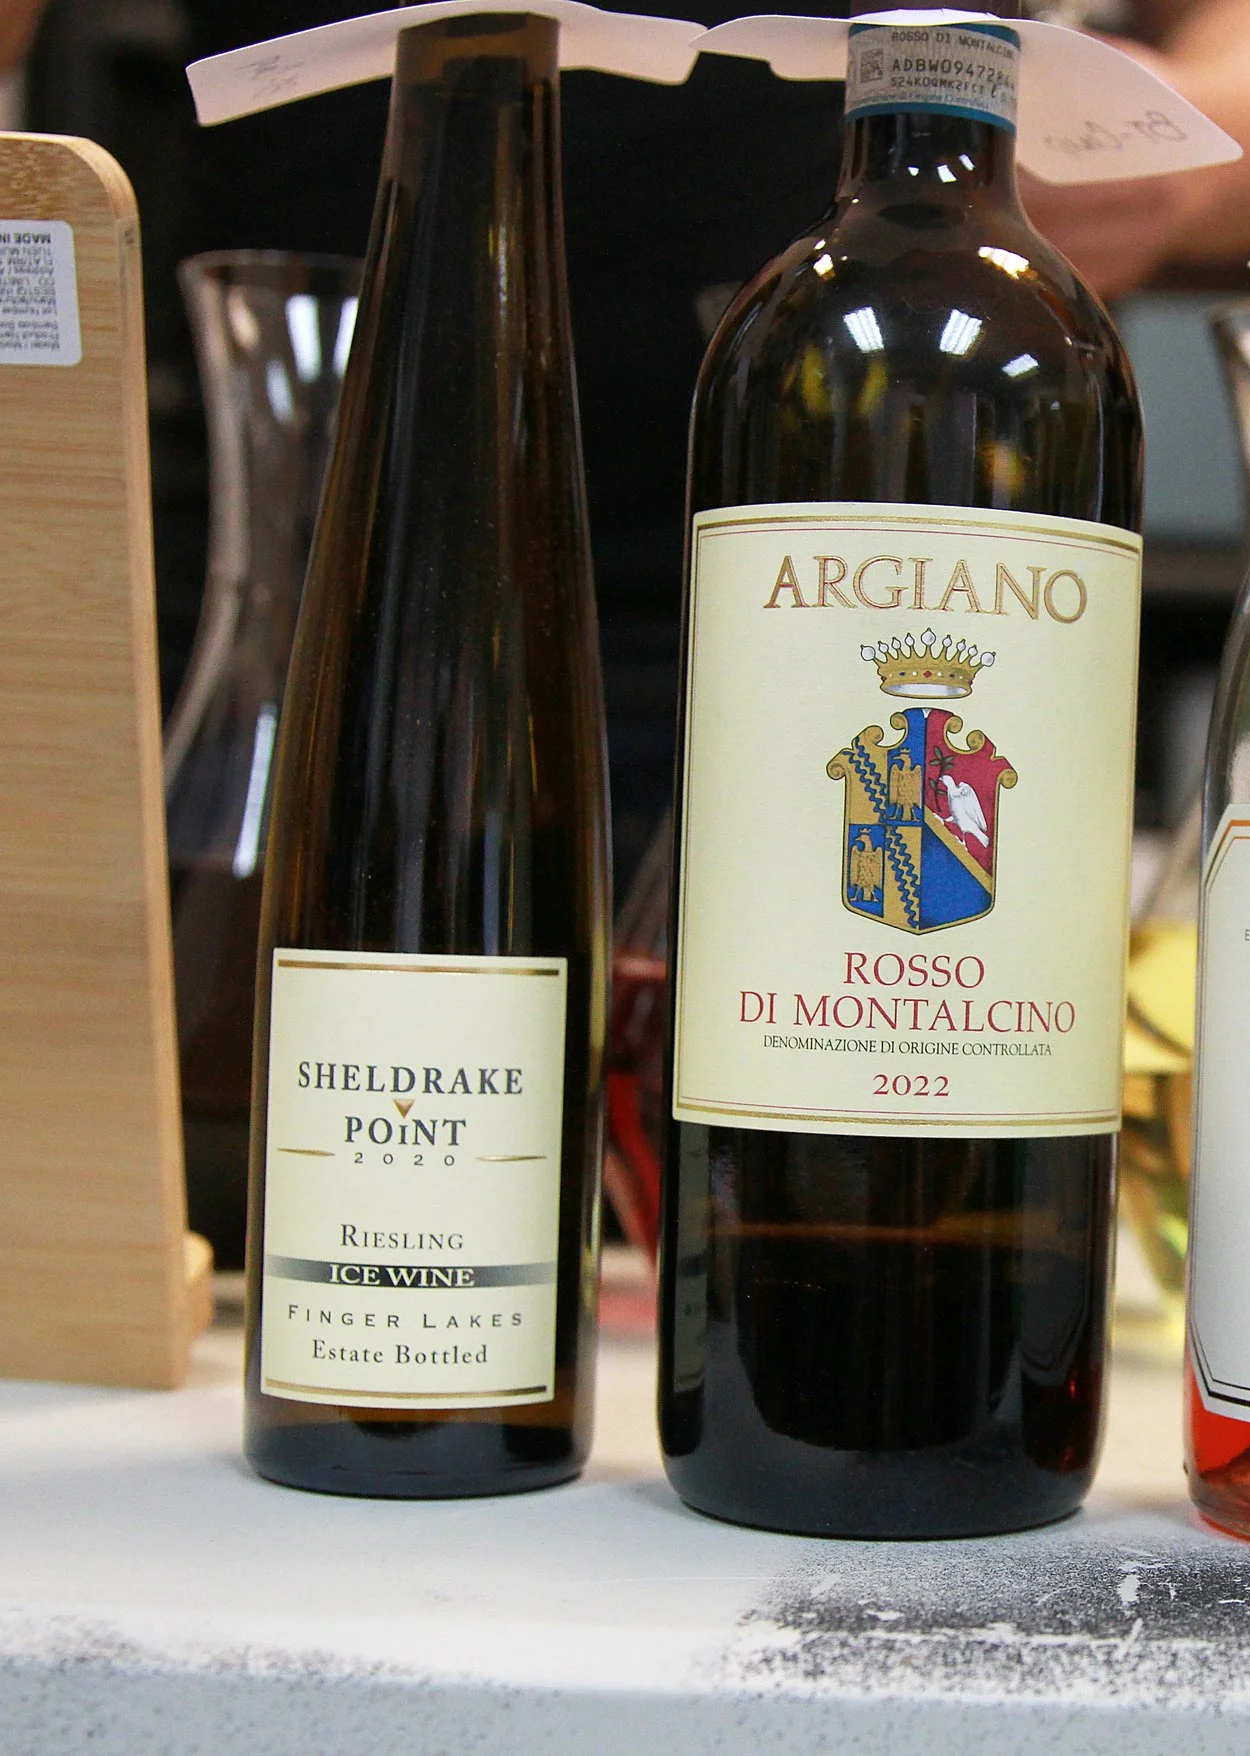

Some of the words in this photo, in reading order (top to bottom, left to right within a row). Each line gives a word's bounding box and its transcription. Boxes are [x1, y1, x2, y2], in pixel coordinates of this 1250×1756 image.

[891, 31, 929, 42] ROSSO
[936, 32, 951, 44] DI
[959, 35, 1014, 60] MONTALCIN
[14, 233, 51, 244] MADE
[763, 555, 1087, 624] ARGIANO
[843, 951, 985, 989] ROSSO
[739, 990, 778, 1025] DI
[793, 993, 1075, 1034] MONTALCINO
[763, 1035, 877, 1054] DENOMINAZIONE
[881, 1042, 895, 1054] DI
[899, 1041, 959, 1056] ORIGINE
[962, 1043, 1052, 1057] CONTROLLATA
[298, 1062, 523, 1094] SHELDRAKE
[873, 1074, 950, 1097] 2022
[344, 1117, 467, 1146] POINT
[354, 1152, 456, 1167] 2020
[340, 1224, 464, 1251] RIESLING
[329, 1264, 380, 1286] ICE
[387, 1266, 475, 1288] WINE
[288, 1304, 400, 1329] FINGER
[423, 1313, 523, 1329] LAKES
[312, 1339, 384, 1364] Estate
[395, 1345, 488, 1365] Bottled
